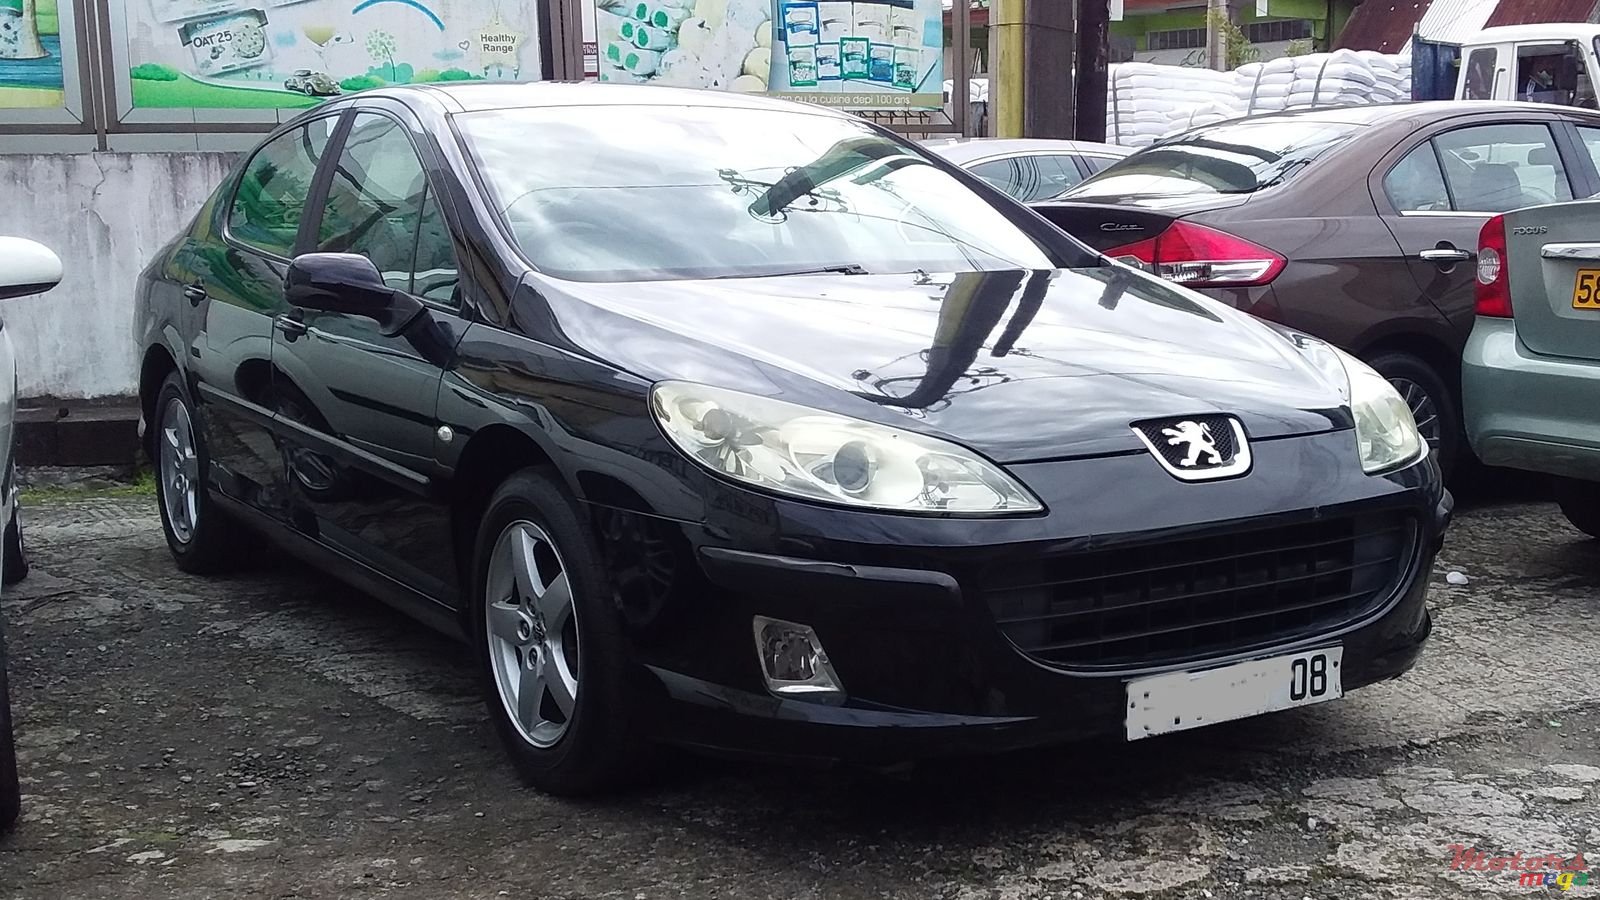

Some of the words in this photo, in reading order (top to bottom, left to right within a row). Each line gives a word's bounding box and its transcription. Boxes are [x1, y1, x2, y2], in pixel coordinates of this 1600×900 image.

[193, 34, 216, 48] OAT
[217, 30, 233, 44] 25
[480, 33, 517, 44] Healthy
[483, 43, 514, 54] Range
[820, 94, 851, 104] cuisine
[852, 94, 873, 105] depi
[876, 95, 892, 104] 100
[894, 96, 910, 105] ans
[1100, 222, 1145, 231] Ciaz
[1513, 225, 1548, 235] FOCUS
[1290, 653, 1327, 701] 08
